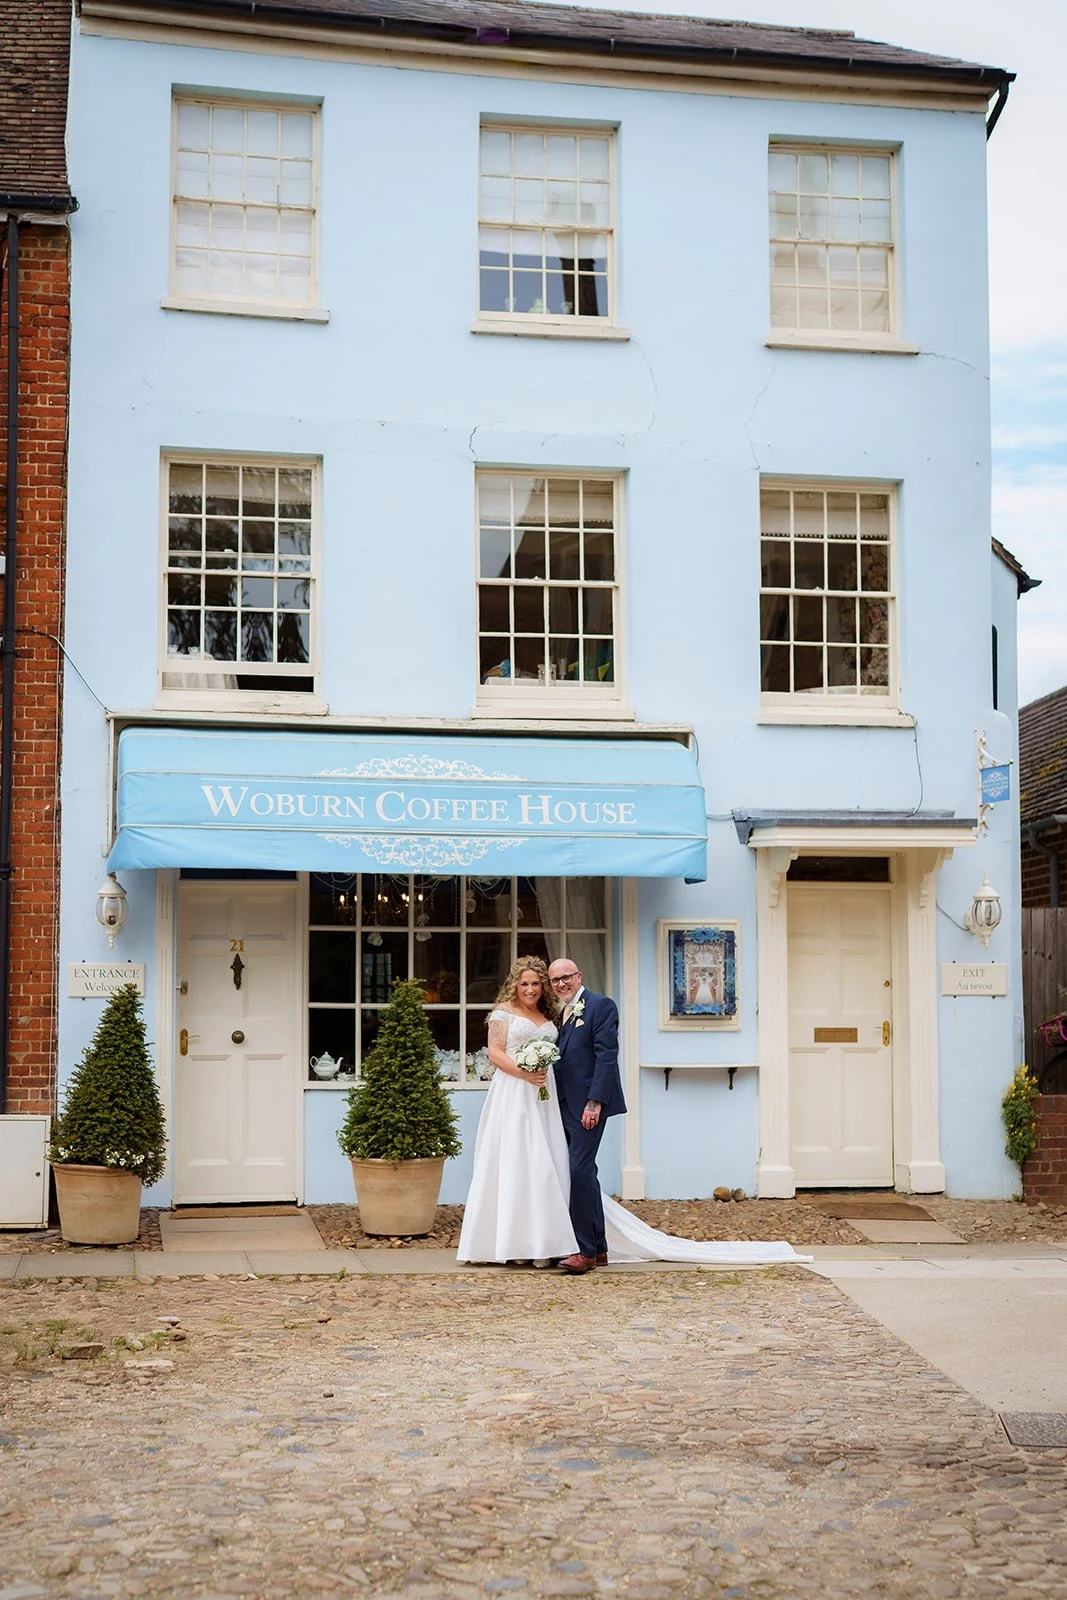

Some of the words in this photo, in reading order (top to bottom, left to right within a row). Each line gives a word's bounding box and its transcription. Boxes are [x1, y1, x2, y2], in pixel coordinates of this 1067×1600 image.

[201, 785, 366, 818] WOBURN
[375, 790, 510, 822] COFFEE
[517, 794, 637, 825] HOUSE
[229, 937, 245, 952] 21
[74, 968, 140, 978] ENTRANCE
[962, 968, 986, 978] EXIT
[84, 982, 127, 992] Welcom
[956, 981, 969, 990] Au
